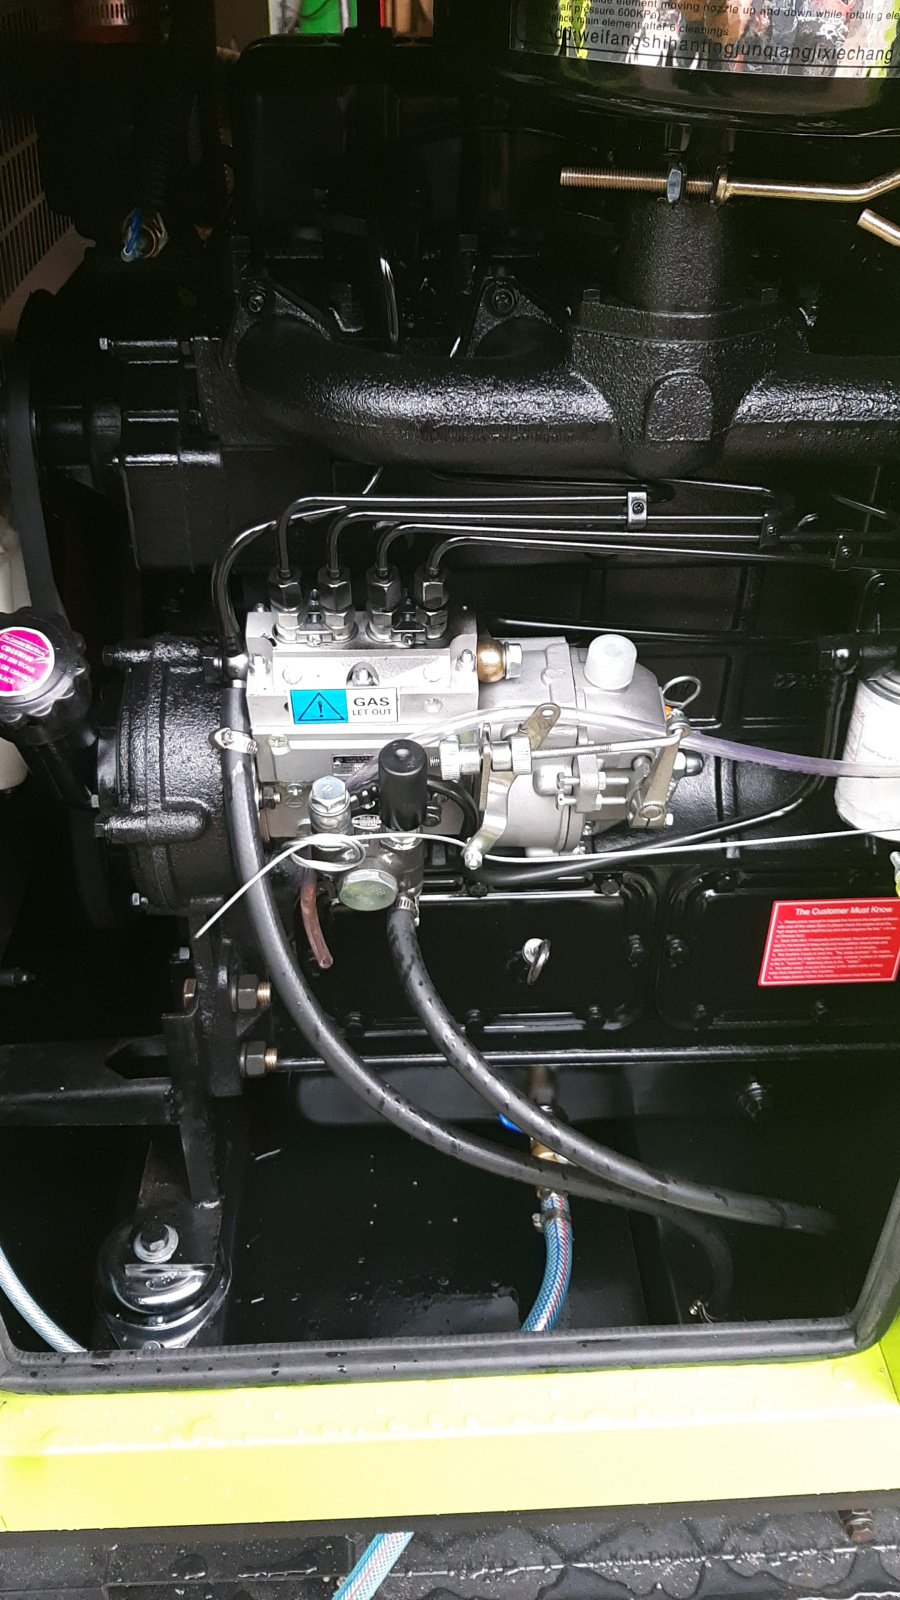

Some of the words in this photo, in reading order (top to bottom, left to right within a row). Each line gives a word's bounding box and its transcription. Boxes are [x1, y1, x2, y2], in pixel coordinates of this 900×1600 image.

[574, 5, 615, 15] pressure
[617, 8, 660, 21] 600KPa)
[660, 0, 700, 12] moving
[703, 4, 739, 14] nozzle
[742, 6, 756, 15] up
[760, 7, 780, 16] and
[783, 8, 812, 17] down
[816, 9, 842, 18] while
[846, 10, 883, 21] rotating
[576, 16, 599, 25] main
[601, 17, 640, 29] element
[643, 22, 667, 31] after
[669, 23, 676, 31] 6
[679, 25, 729, 36] cleanings
[353, 696, 390, 707] GAS
[352, 708, 368, 716] LET
[371, 708, 392, 716] OUT
[795, 907, 811, 916] The
[811, 906, 850, 916] Customer
[850, 905, 870, 914] Must
[870, 905, 894, 914] Know
